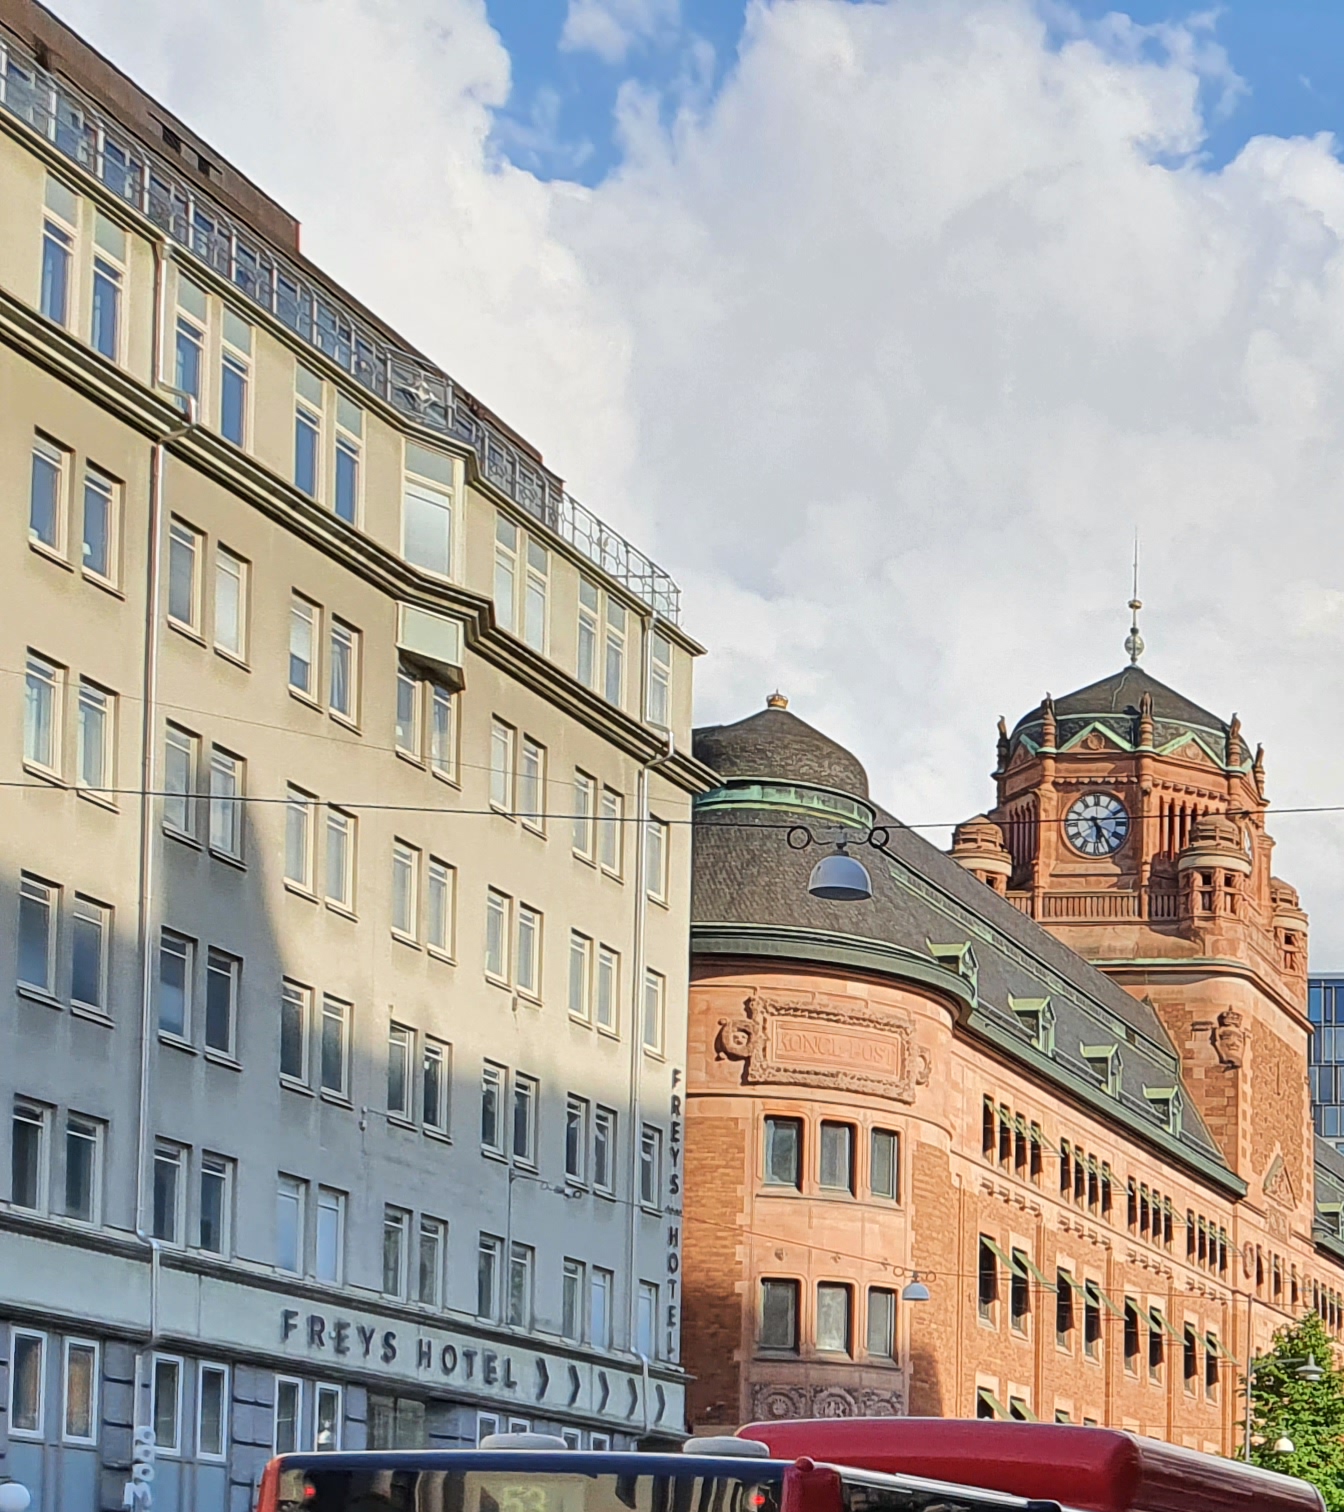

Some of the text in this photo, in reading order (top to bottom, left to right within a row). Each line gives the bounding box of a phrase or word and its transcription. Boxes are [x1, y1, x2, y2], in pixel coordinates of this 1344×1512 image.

[666, 1067, 683, 1361] FREYS HOTEL
[280, 1309, 518, 1390] FREYS HOTEL
